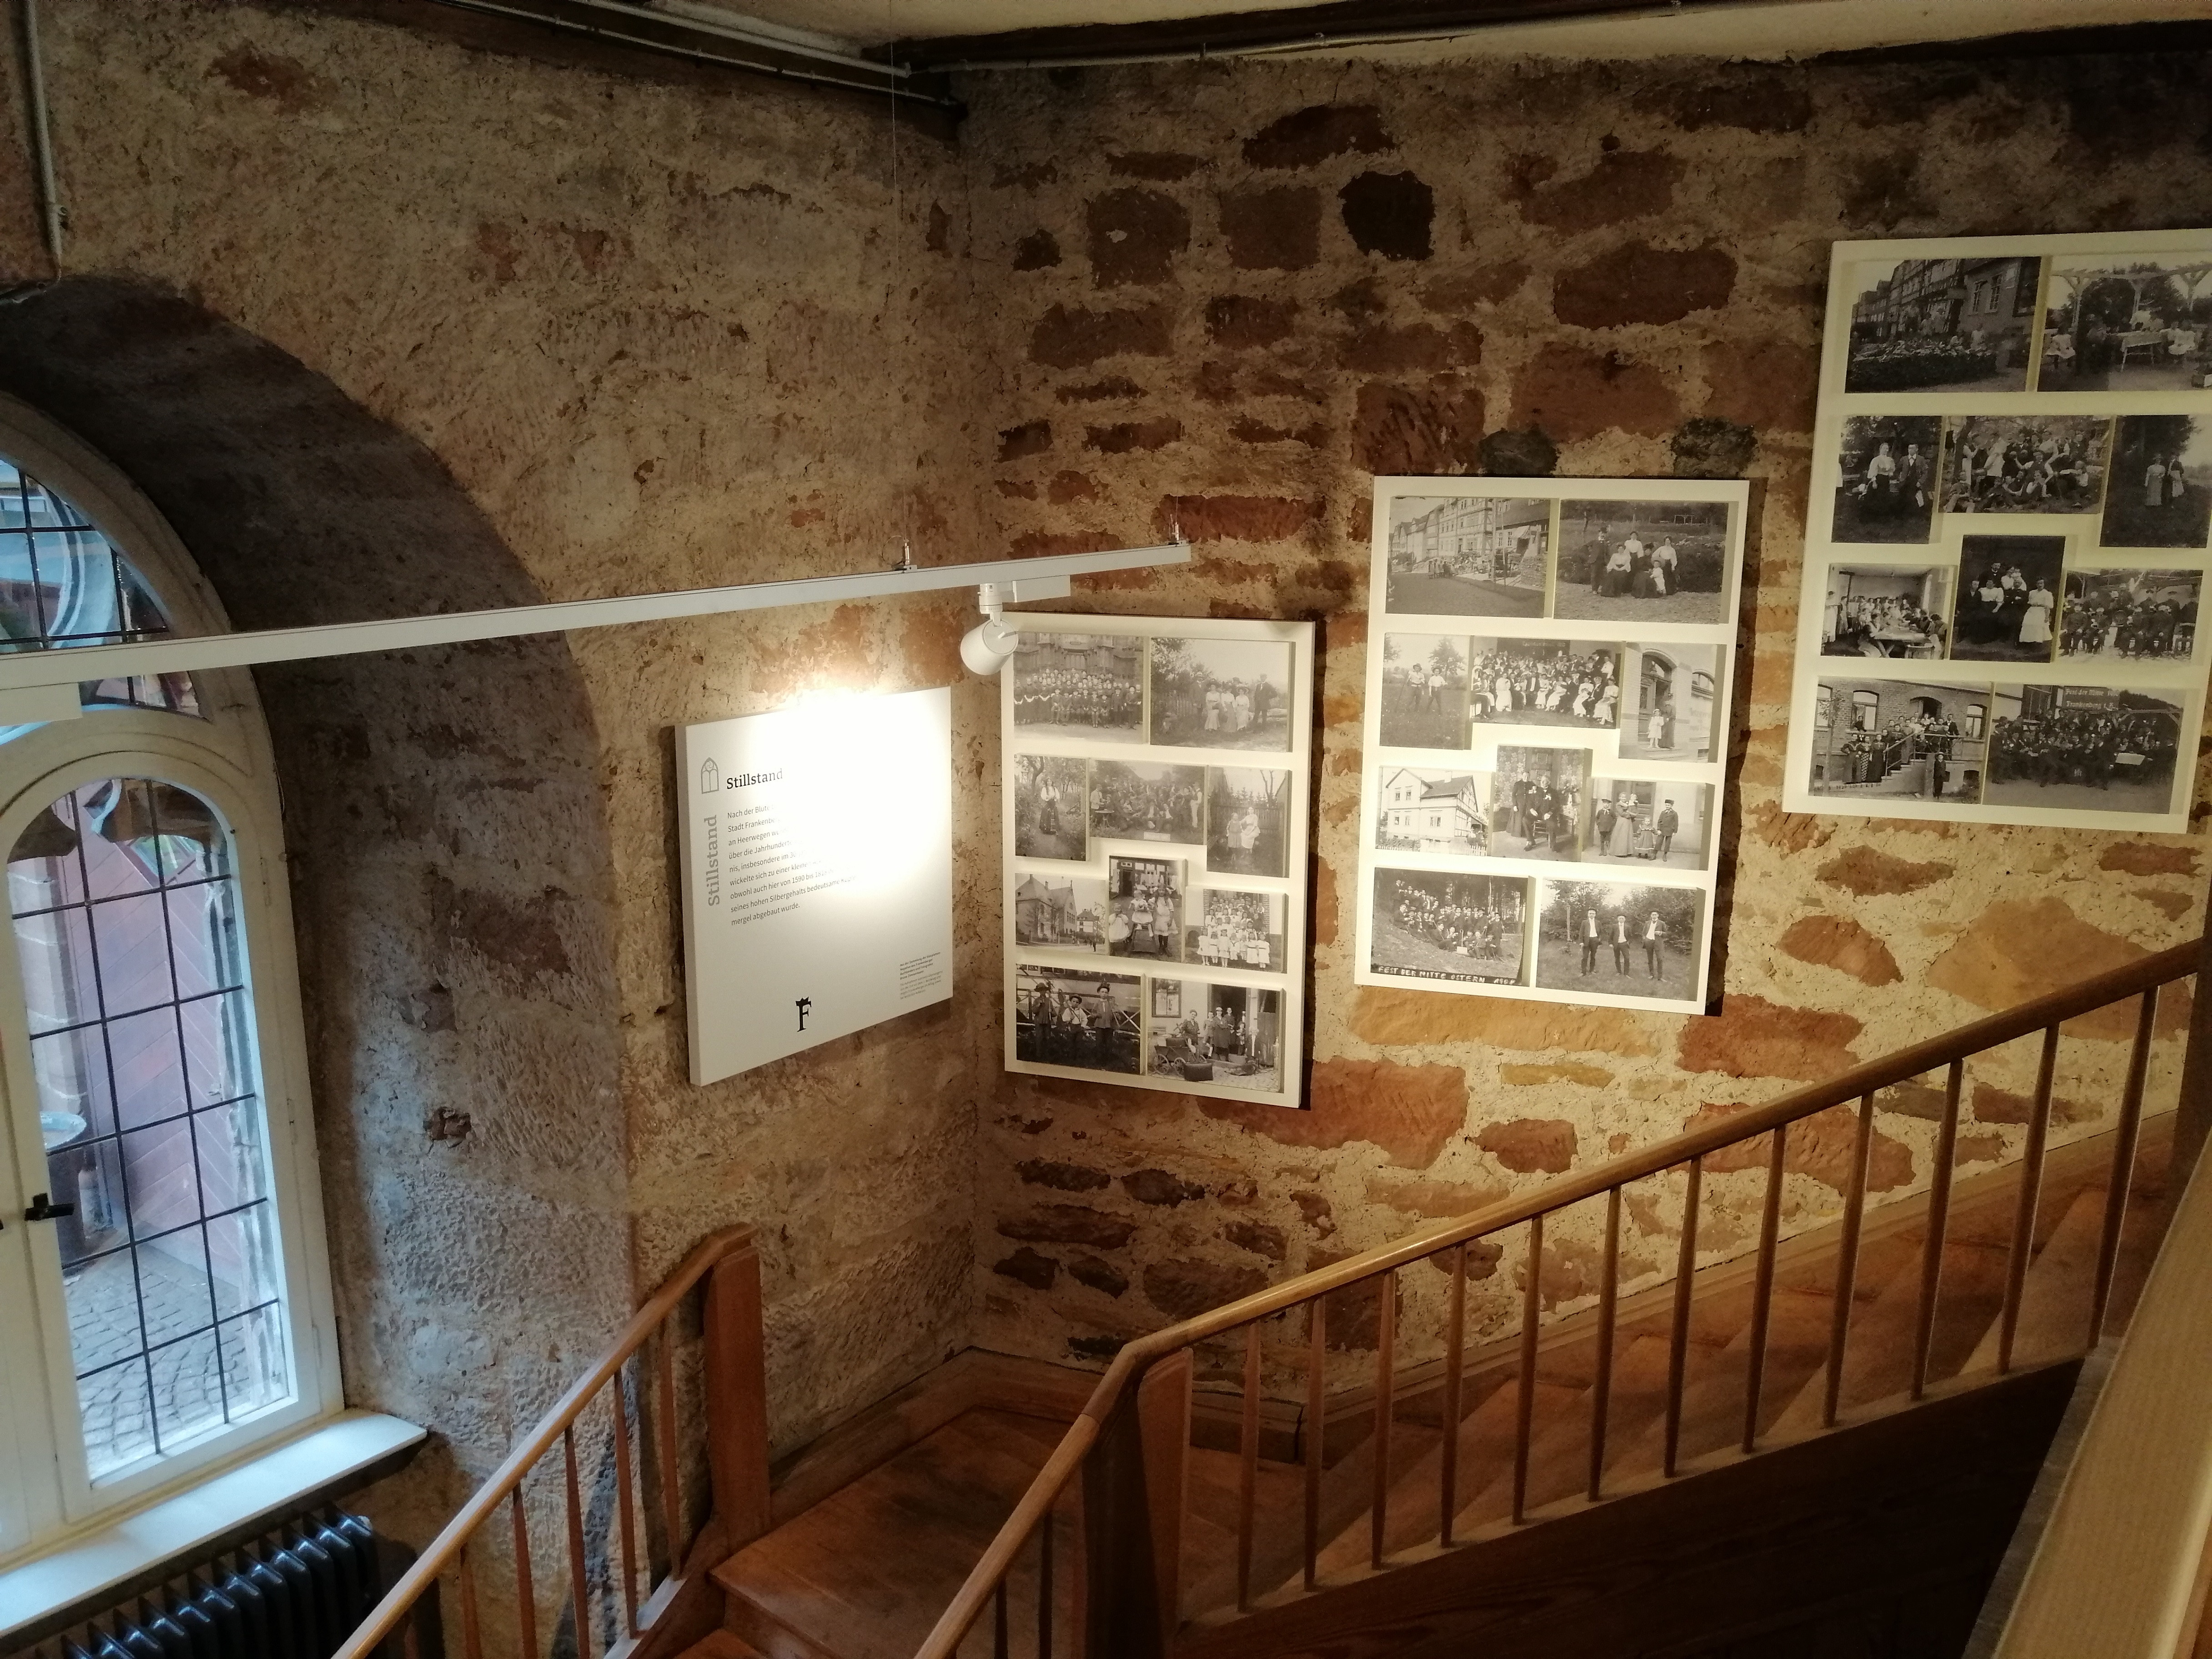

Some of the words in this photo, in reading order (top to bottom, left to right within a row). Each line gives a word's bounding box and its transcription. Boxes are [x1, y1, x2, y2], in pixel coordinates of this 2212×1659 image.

[727, 768, 783, 789] Stillstand
[728, 810, 743, 819] Nach
[728, 823, 744, 832] Stadt
[745, 817, 781, 829] Frankenbe
[738, 832, 770, 844] Heerwegen
[704, 814, 720, 906] Stillstand
[729, 851, 742, 859] über
[741, 856, 780, 870] insbesondere
[730, 874, 754, 885] wickelte
[755, 871, 767, 880] sich
[776, 867, 790, 875] einer
[791, 862, 811, 871] kleine
[730, 889, 752, 899] obwohl
[754, 885, 767, 894] auch
[769, 881, 779, 890] hier
[792, 875, 805, 884] 1590
[731, 904, 749, 913] seines
[750, 897, 769, 908] hohen
[770, 888, 806, 902] Silbergehalts
[807, 879, 840, 892] bedeutsame
[731, 914, 752, 925] mergel
[753, 907, 780, 920] abgebaut
[781, 902, 800, 912] wurde.
[1378, 966, 1398, 974] FEST
[1451, 974, 1485, 983] OSTERN
